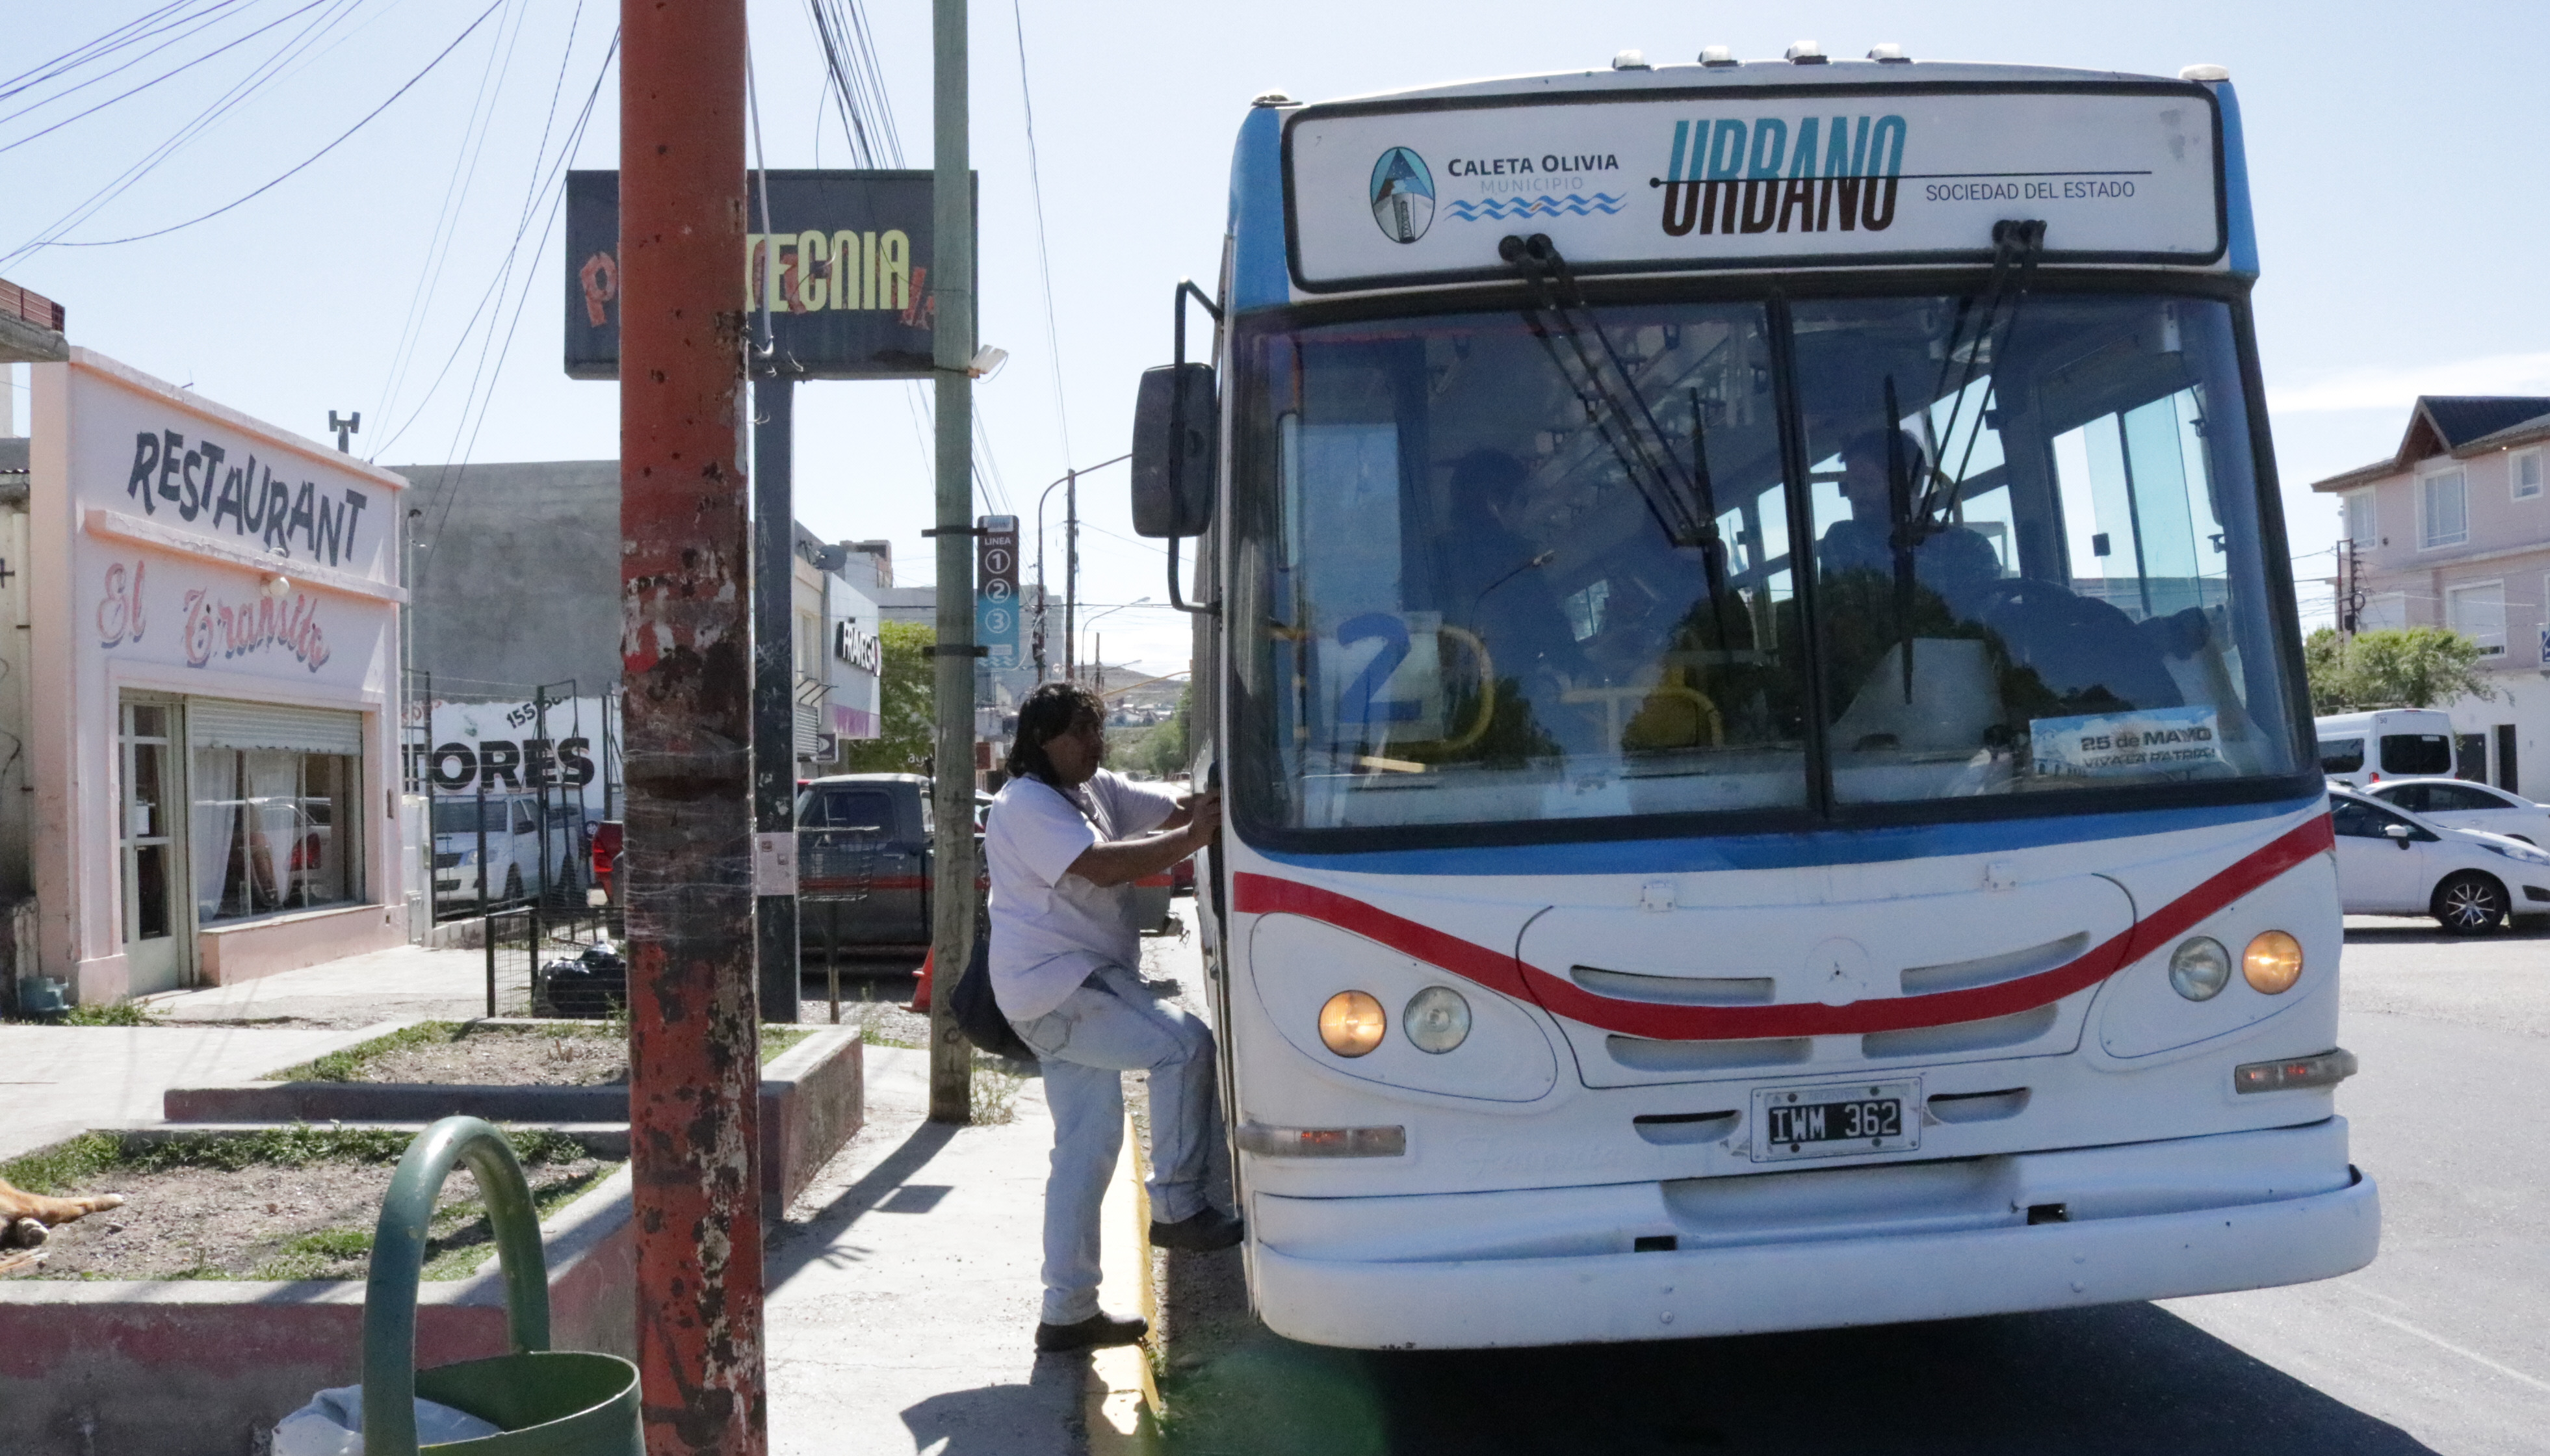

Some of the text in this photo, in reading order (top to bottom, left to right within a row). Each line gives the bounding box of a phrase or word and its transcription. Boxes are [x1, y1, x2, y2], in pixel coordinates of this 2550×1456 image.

[1448, 154, 1619, 176] CALETA OLIVIA
[1662, 114, 1906, 236] URBANO
[1481, 176, 1583, 194] MUNICIPIO
[1926, 181, 2135, 201] SOCIEDAD DEL ESTADO
[127, 428, 367, 567] RESTAURANT
[984, 537, 1011, 545] LINEA
[992, 552, 1002, 569] 1
[993, 582, 1005, 599] 2
[97, 560, 146, 649] El
[993, 613, 1004, 629] 3
[1336, 613, 1422, 723] 2
[2081, 725, 2211, 751] 25 de MAYO
[1773, 1102, 1897, 1142] IWM 362
